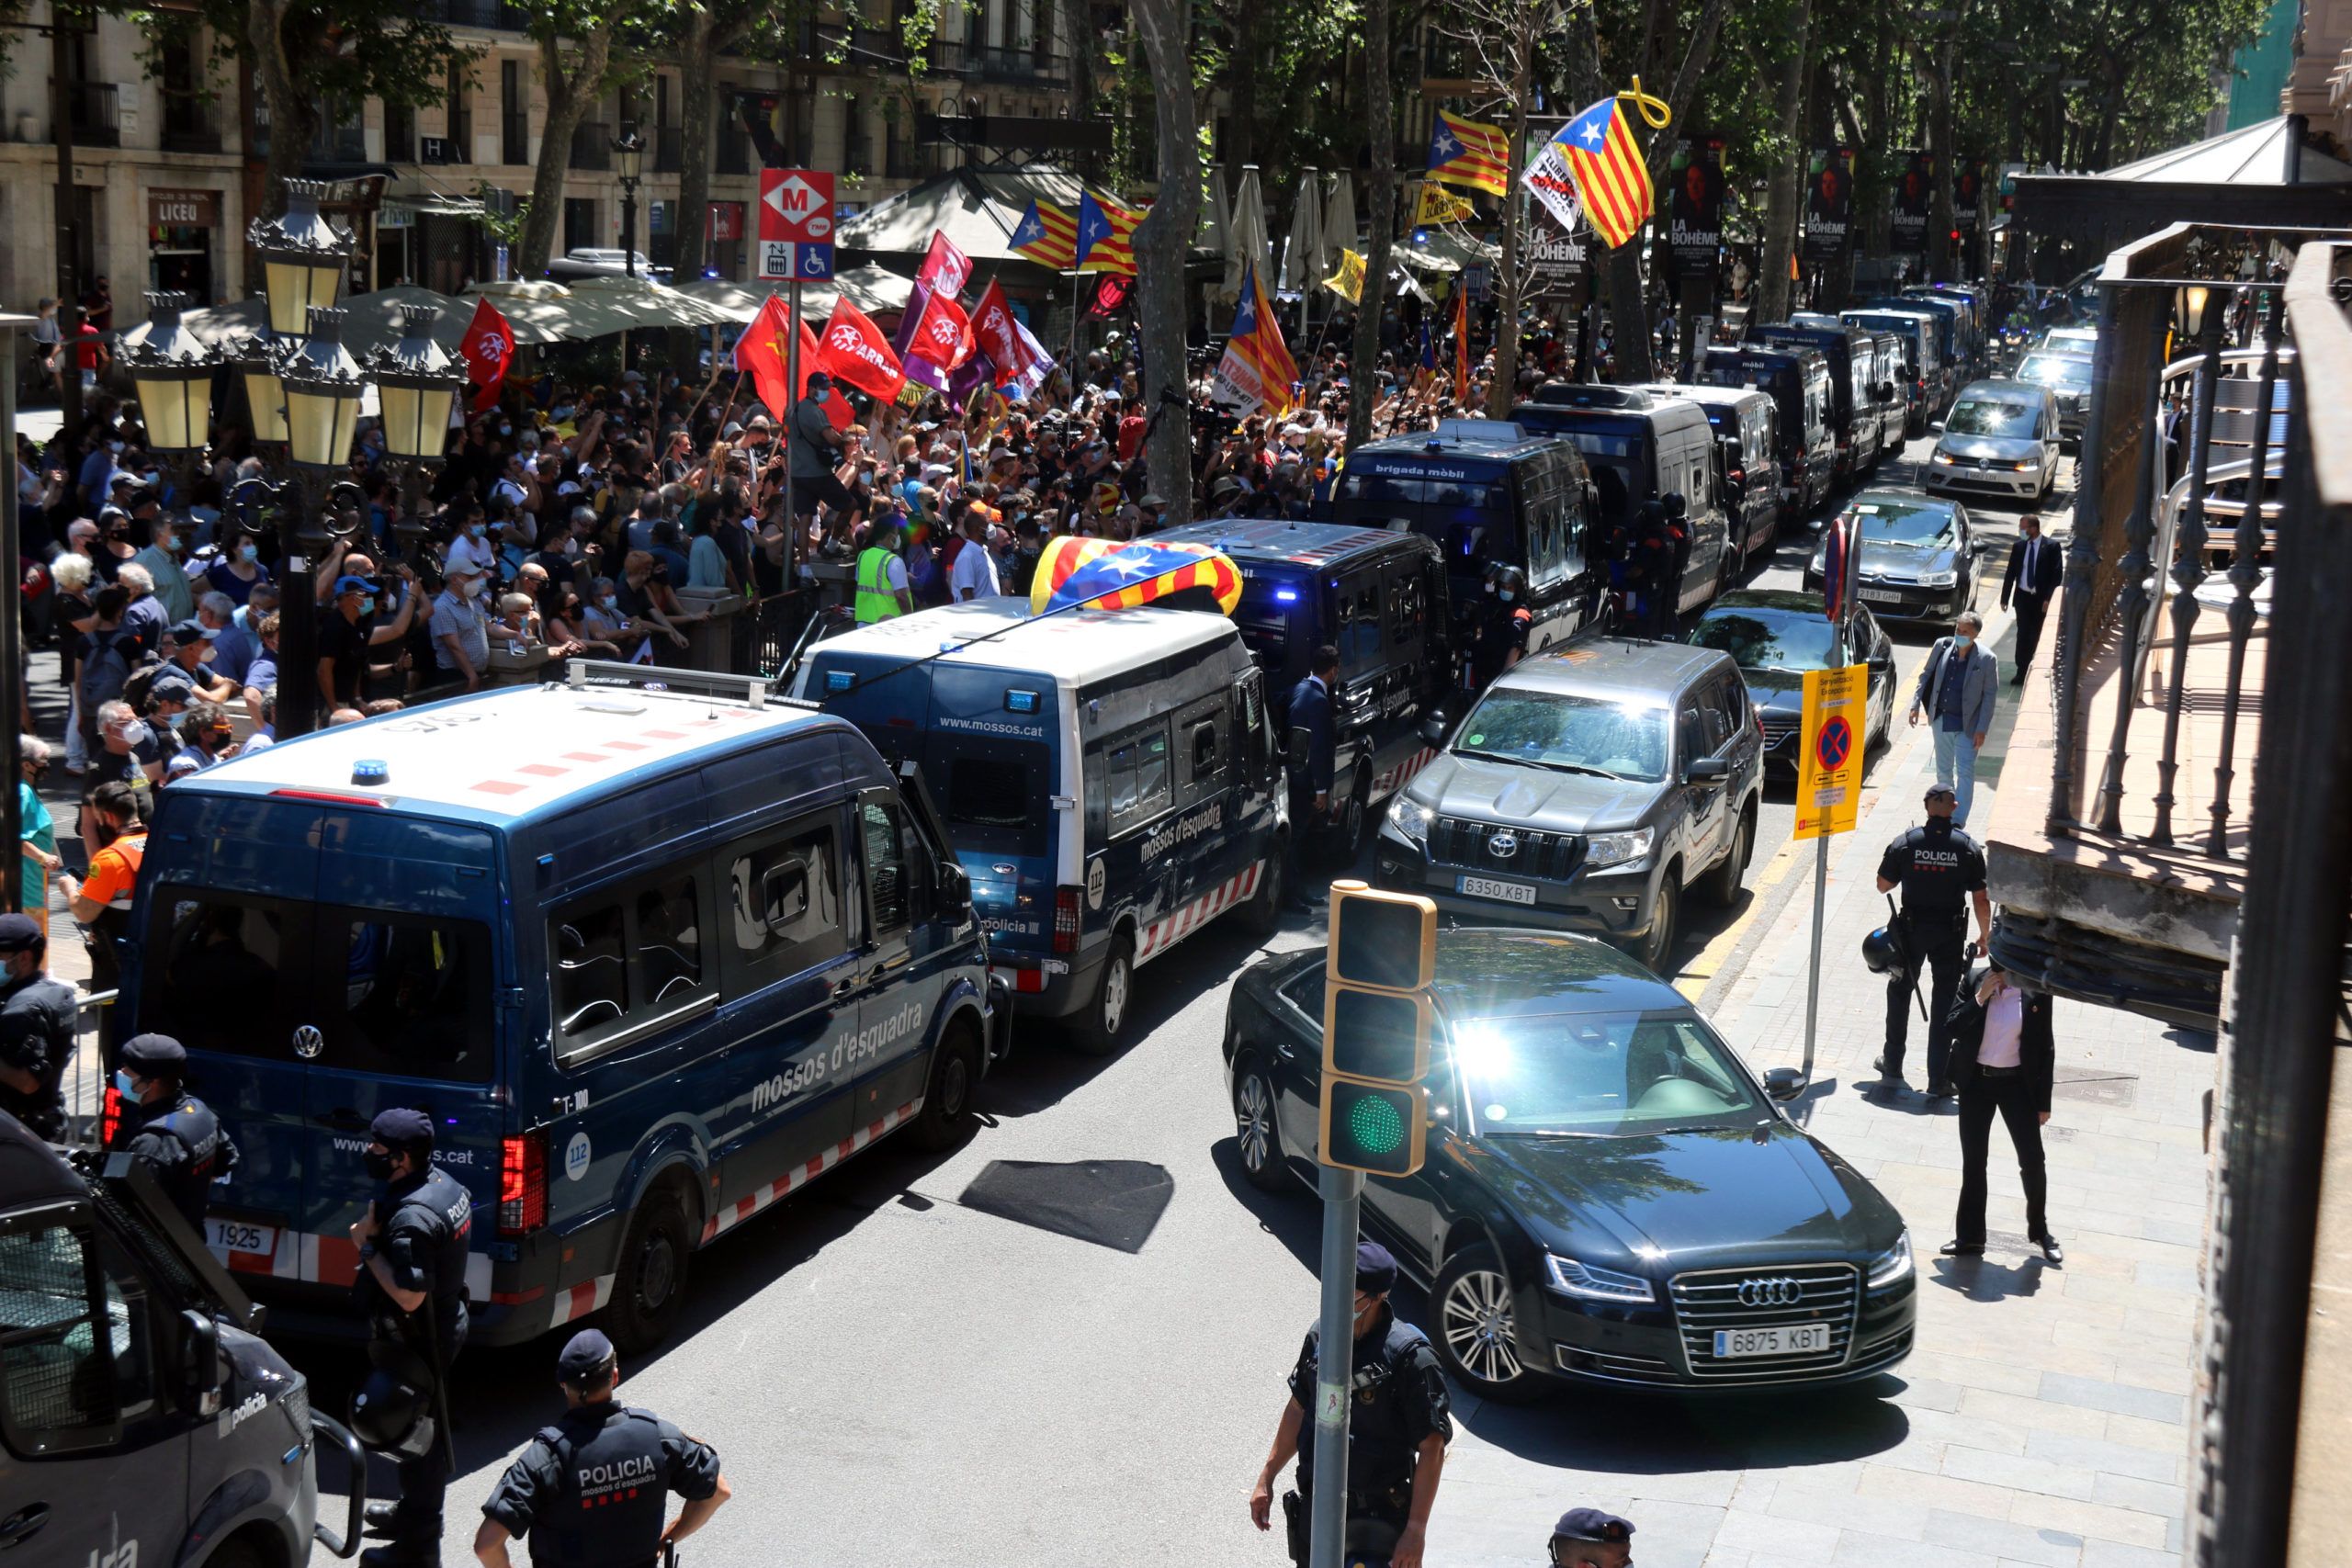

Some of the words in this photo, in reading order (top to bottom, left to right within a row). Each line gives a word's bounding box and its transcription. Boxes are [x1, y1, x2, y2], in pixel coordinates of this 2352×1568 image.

[427, 140, 441, 156] H
[782, 187, 808, 212] M
[159, 203, 198, 221] LICEU
[1808, 211, 1820, 222] LA
[1671, 219, 1686, 232] LA
[1807, 220, 1847, 234] BOHÈME
[1671, 229, 1719, 246] BOHÈME
[1375, 465, 1425, 475] brigada
[1428, 468, 1464, 479] mòbil
[940, 717, 1043, 737] www.mossos.cat
[1140, 828, 1174, 863] mossos
[1175, 802, 1221, 843] d'esquadra
[1915, 850, 1958, 863] POLICIA
[1090, 870, 1102, 891] 112
[1465, 879, 1501, 897] 6350
[1506, 885, 1532, 902] KBT
[983, 919, 1026, 934] policia
[752, 1051, 826, 1113] mossos
[831, 1002, 922, 1071] d'esquadra
[562, 1089, 589, 1114] T-100
[570, 1143, 587, 1164] 112
[219, 1224, 261, 1249] 1925
[1733, 1332, 1779, 1352] 6875
[1789, 1328, 1823, 1349] KBT
[232, 1392, 267, 1430] policia
[579, 1455, 656, 1487] POLICIA
[582, 1483, 613, 1497] mossos
[615, 1472, 657, 1490] d'esquadra
